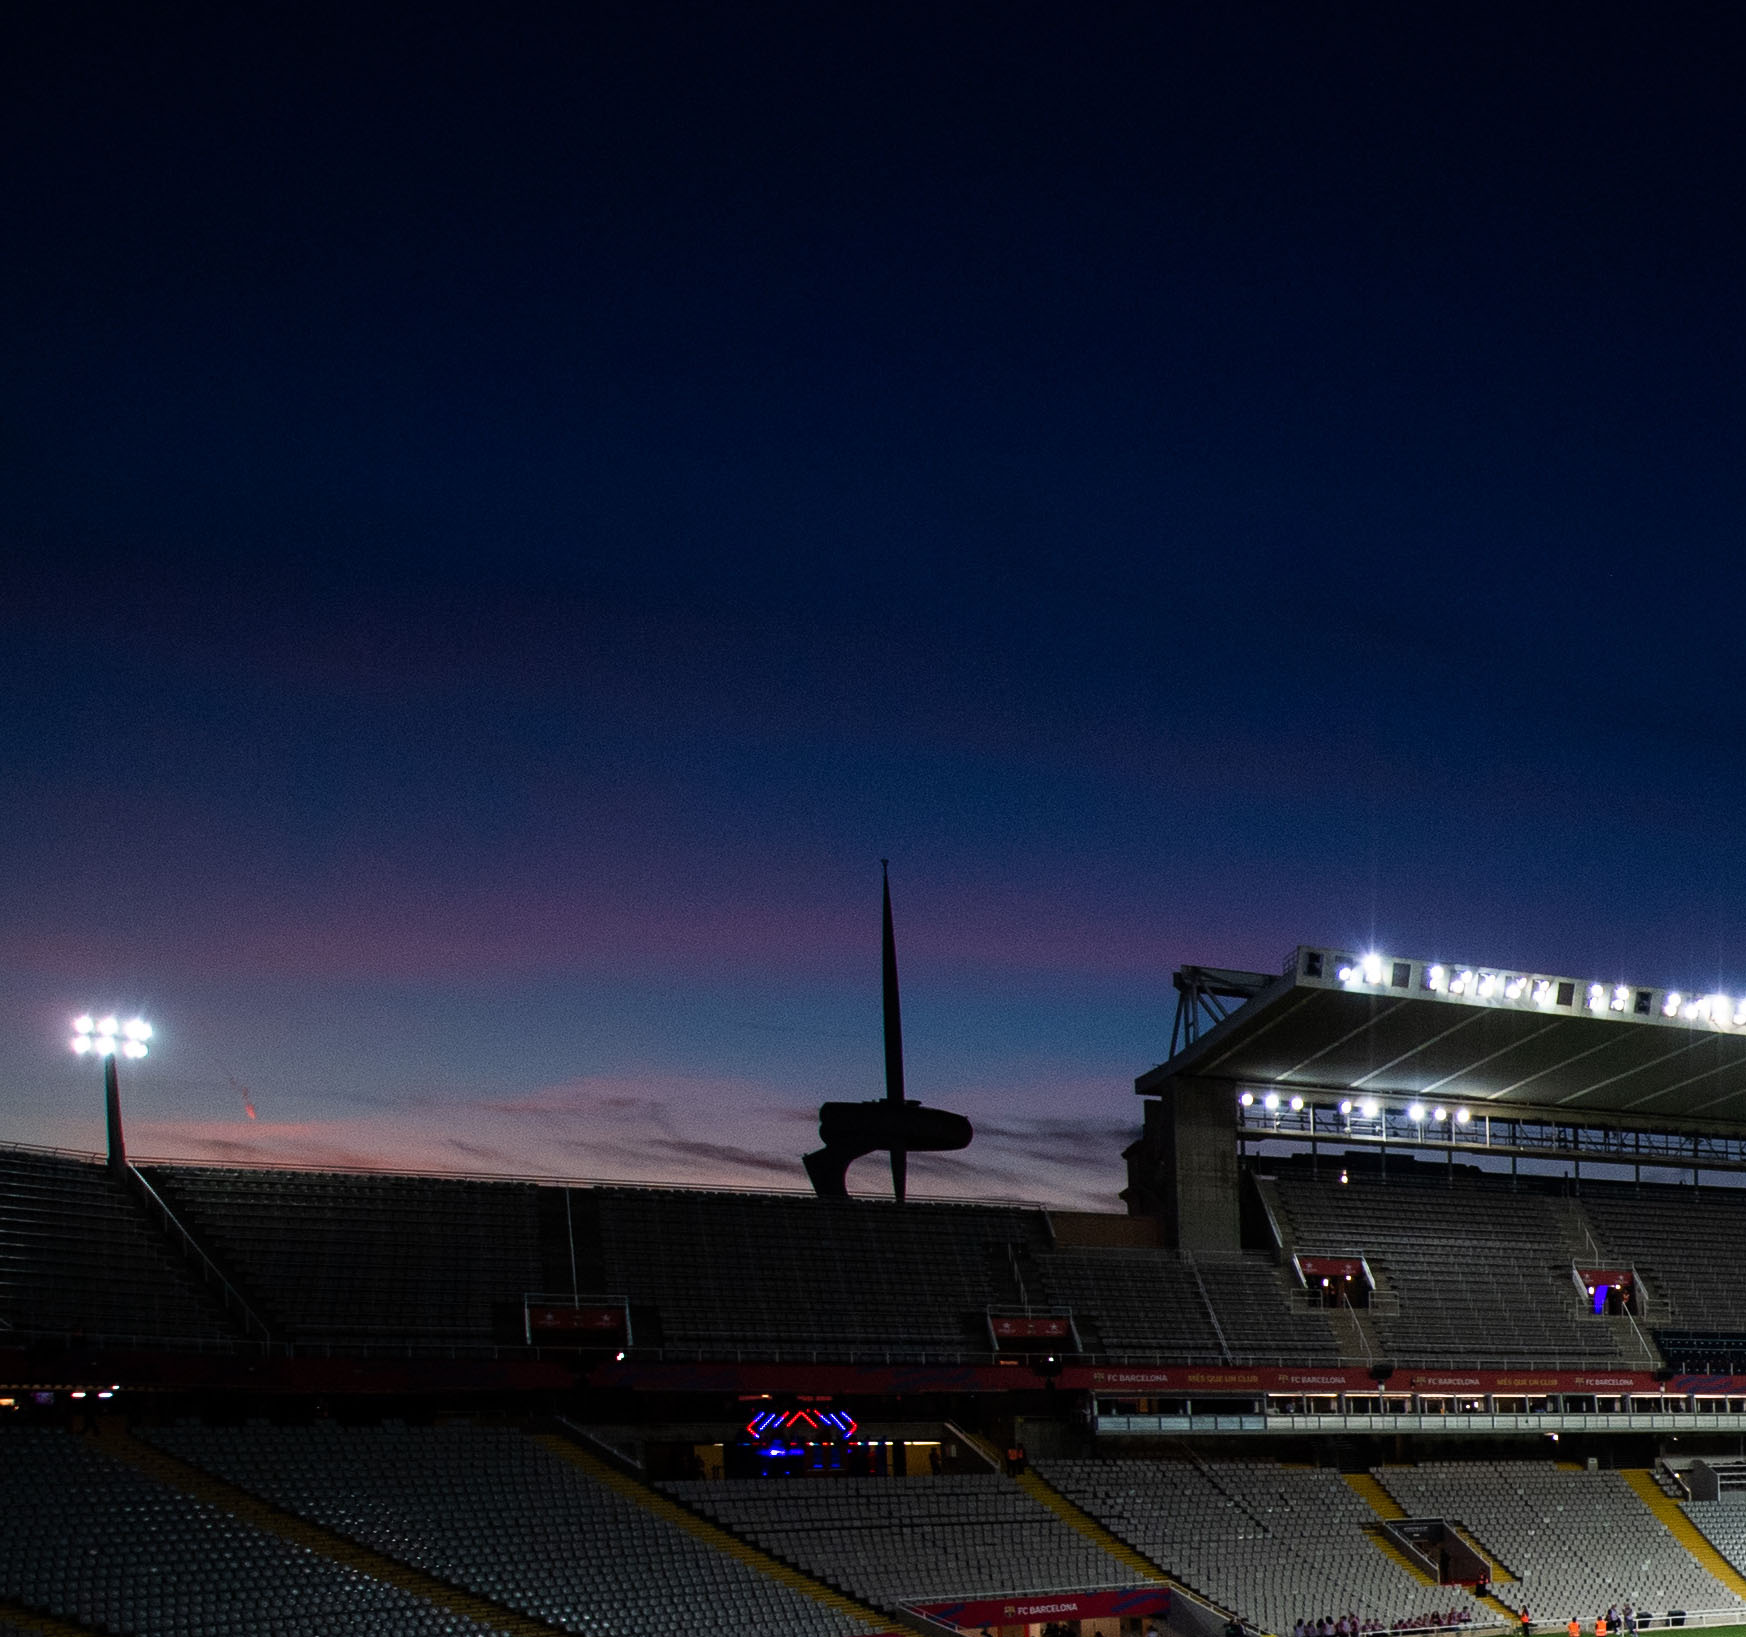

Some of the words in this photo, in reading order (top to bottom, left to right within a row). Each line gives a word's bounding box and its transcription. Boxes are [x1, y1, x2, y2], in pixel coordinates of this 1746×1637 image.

[1107, 1374, 1118, 1382] FC
[1119, 1374, 1168, 1382] BARCELONA
[1291, 1376, 1301, 1384] FC
[1302, 1376, 1346, 1384] BARCELONA
[1428, 1377, 1437, 1385] FC
[1438, 1377, 1480, 1386] BARCELONA
[1017, 1607, 1028, 1615] FC
[1029, 1603, 1078, 1614] BARCELONA
